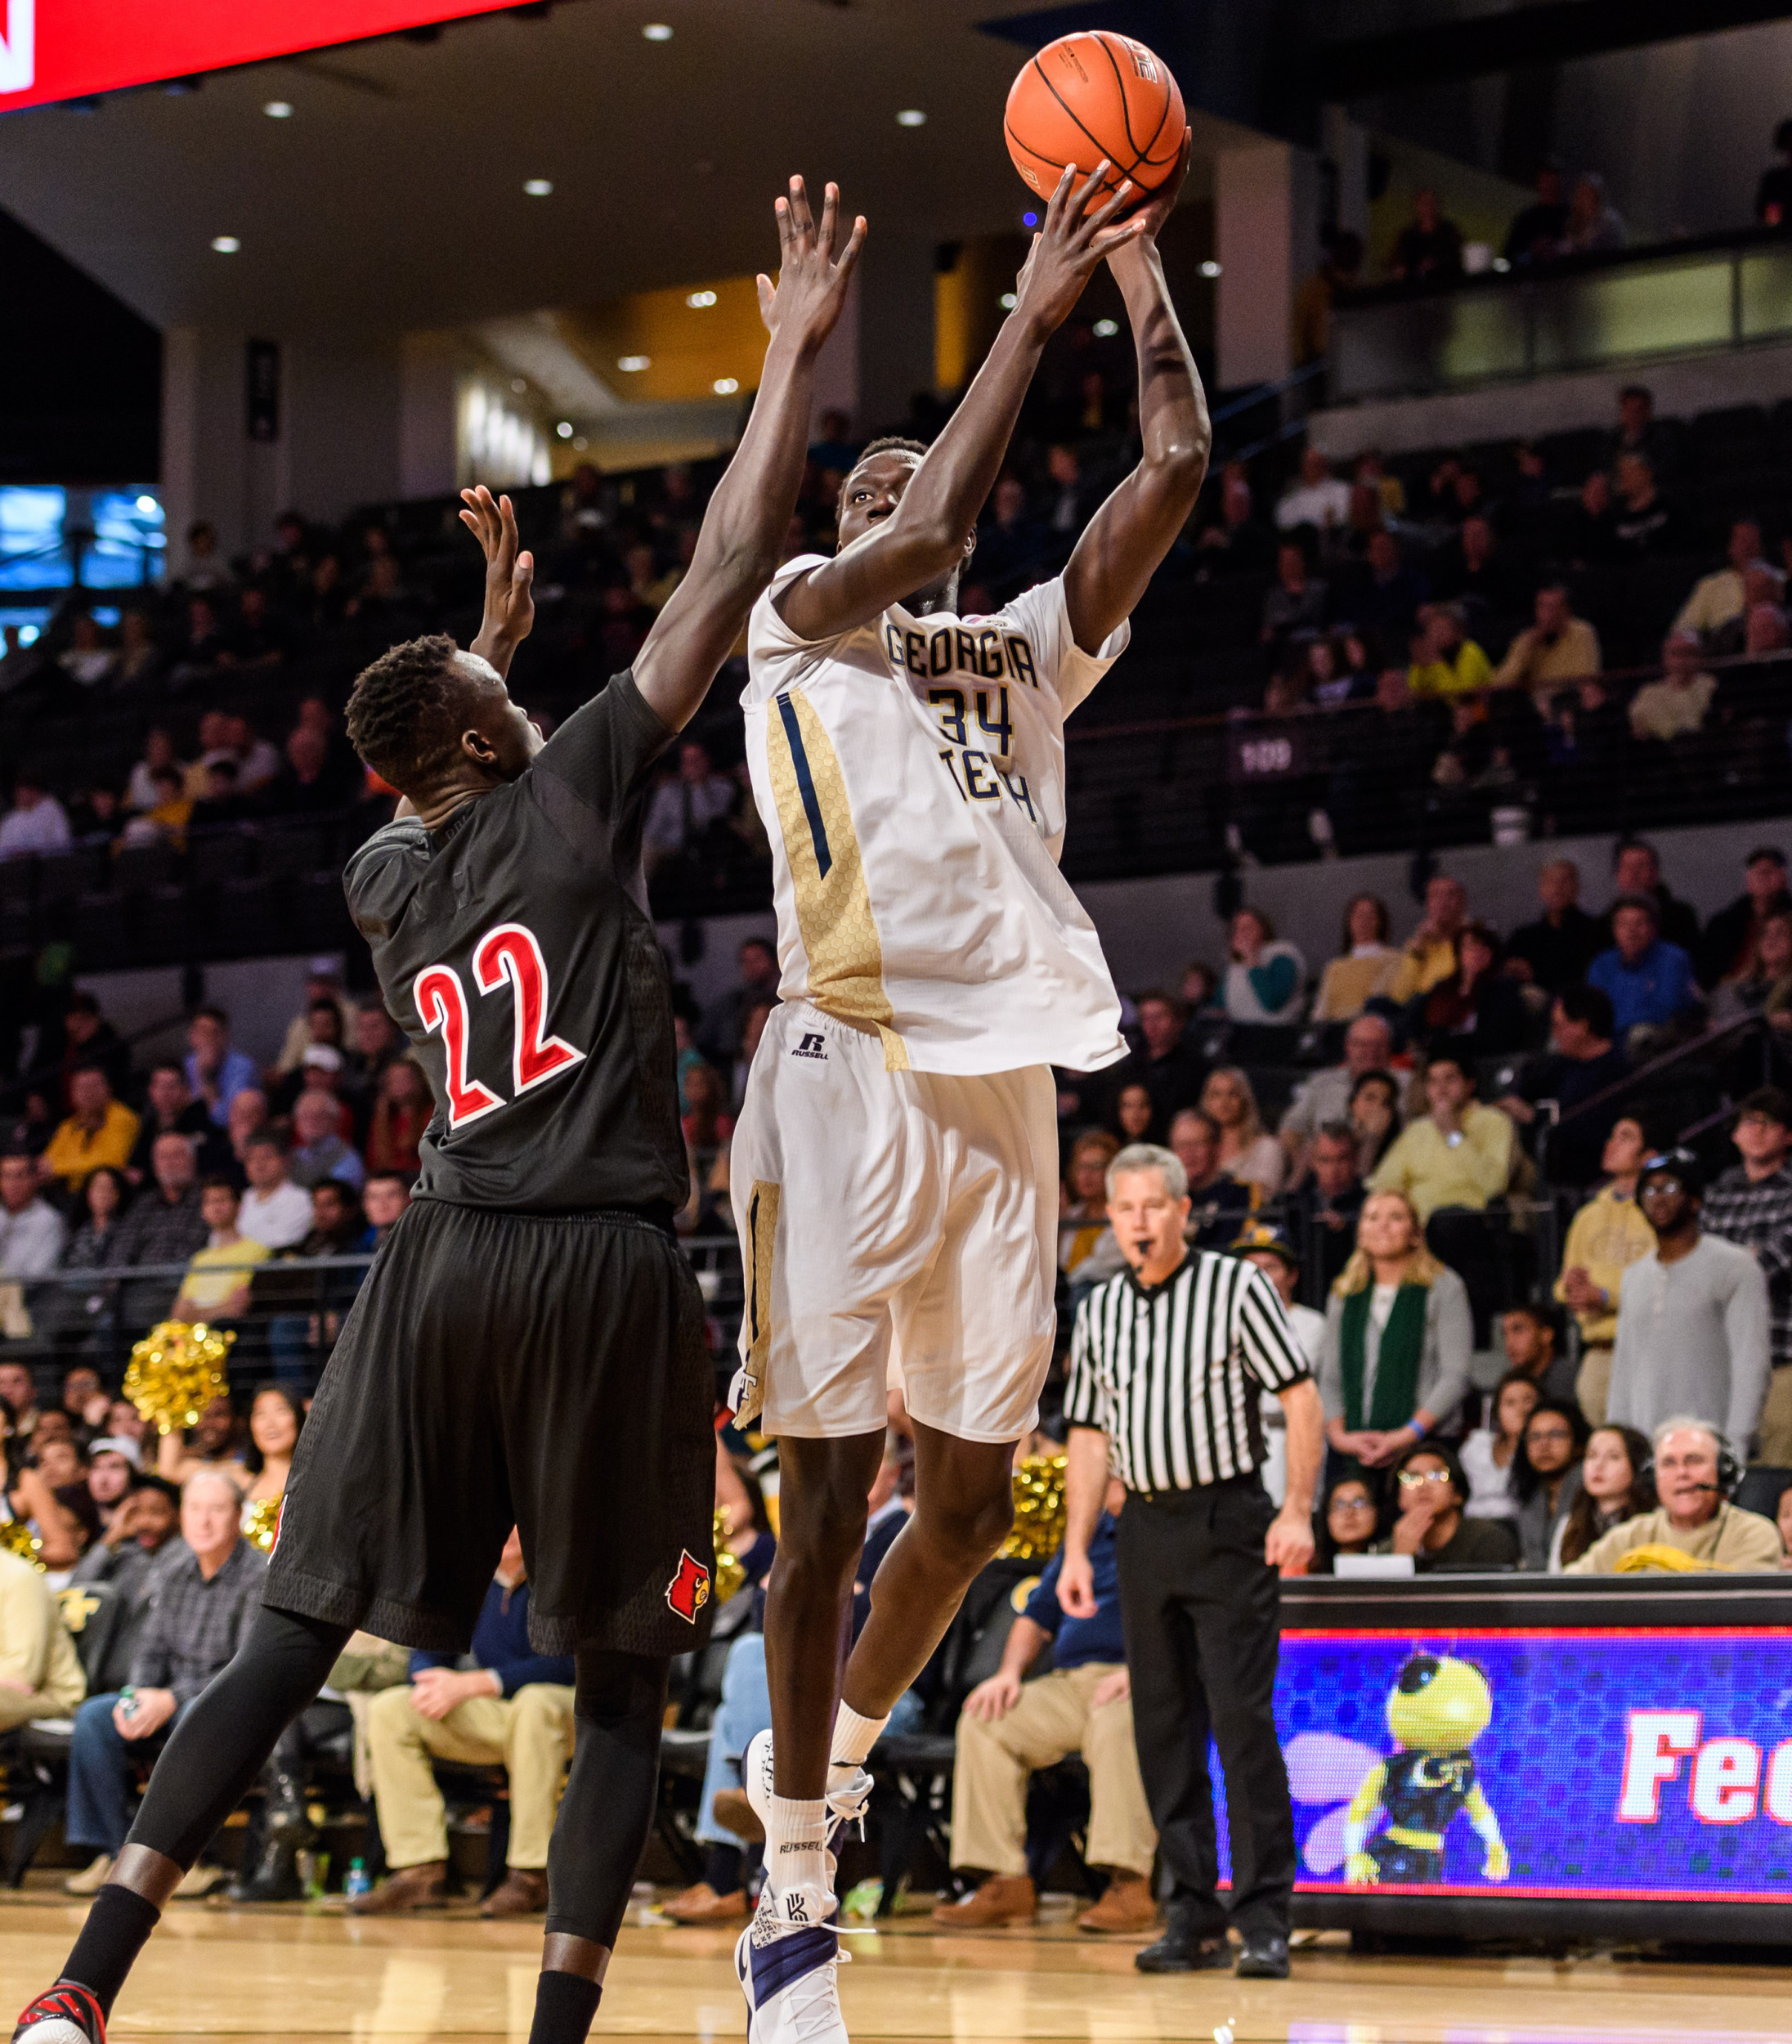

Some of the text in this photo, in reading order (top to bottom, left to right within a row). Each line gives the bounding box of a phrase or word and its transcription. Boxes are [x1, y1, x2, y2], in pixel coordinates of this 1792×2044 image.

[886, 624, 1041, 691] GEORGIA
[927, 680, 1015, 760] 34
[939, 746, 1038, 824] TEH
[413, 922, 588, 1131] 22
[791, 1049, 829, 1060] RUSSELL
